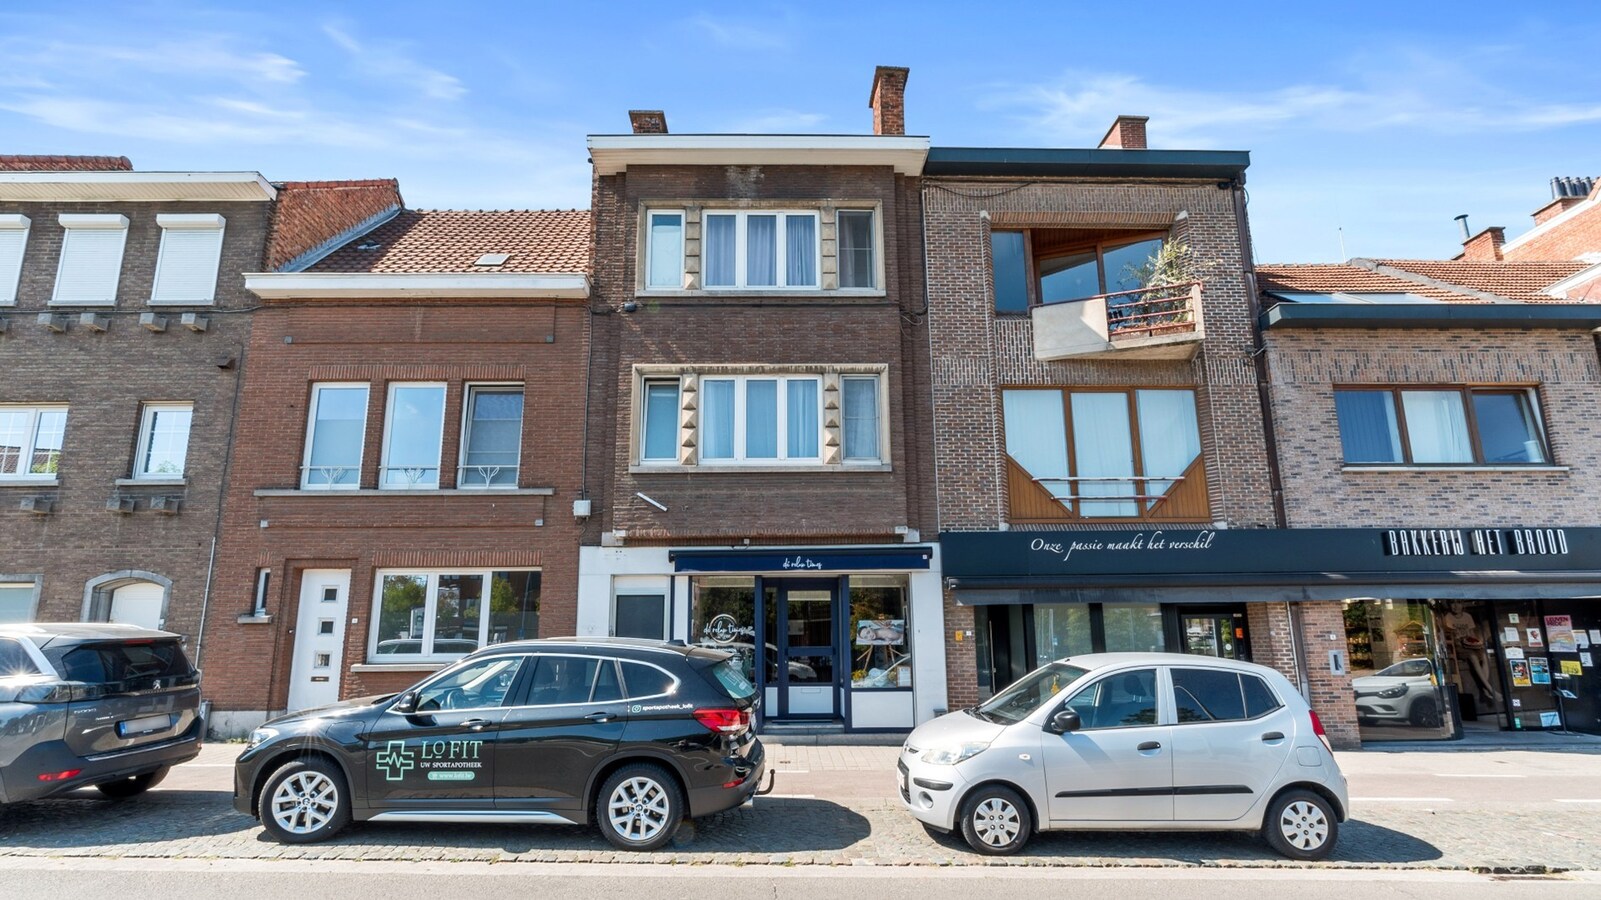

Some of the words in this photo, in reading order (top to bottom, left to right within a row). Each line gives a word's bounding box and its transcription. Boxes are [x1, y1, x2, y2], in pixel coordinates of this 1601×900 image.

[1031, 538, 1064, 554] Onze
[1063, 539, 1104, 561] passie
[1106, 533, 1143, 550] maakt
[1147, 530, 1165, 550] het
[1168, 530, 1215, 550] verschil
[1388, 529, 1465, 555] BAKKERIJ
[1475, 529, 1503, 555] HET
[1514, 529, 1569, 555] BROOD
